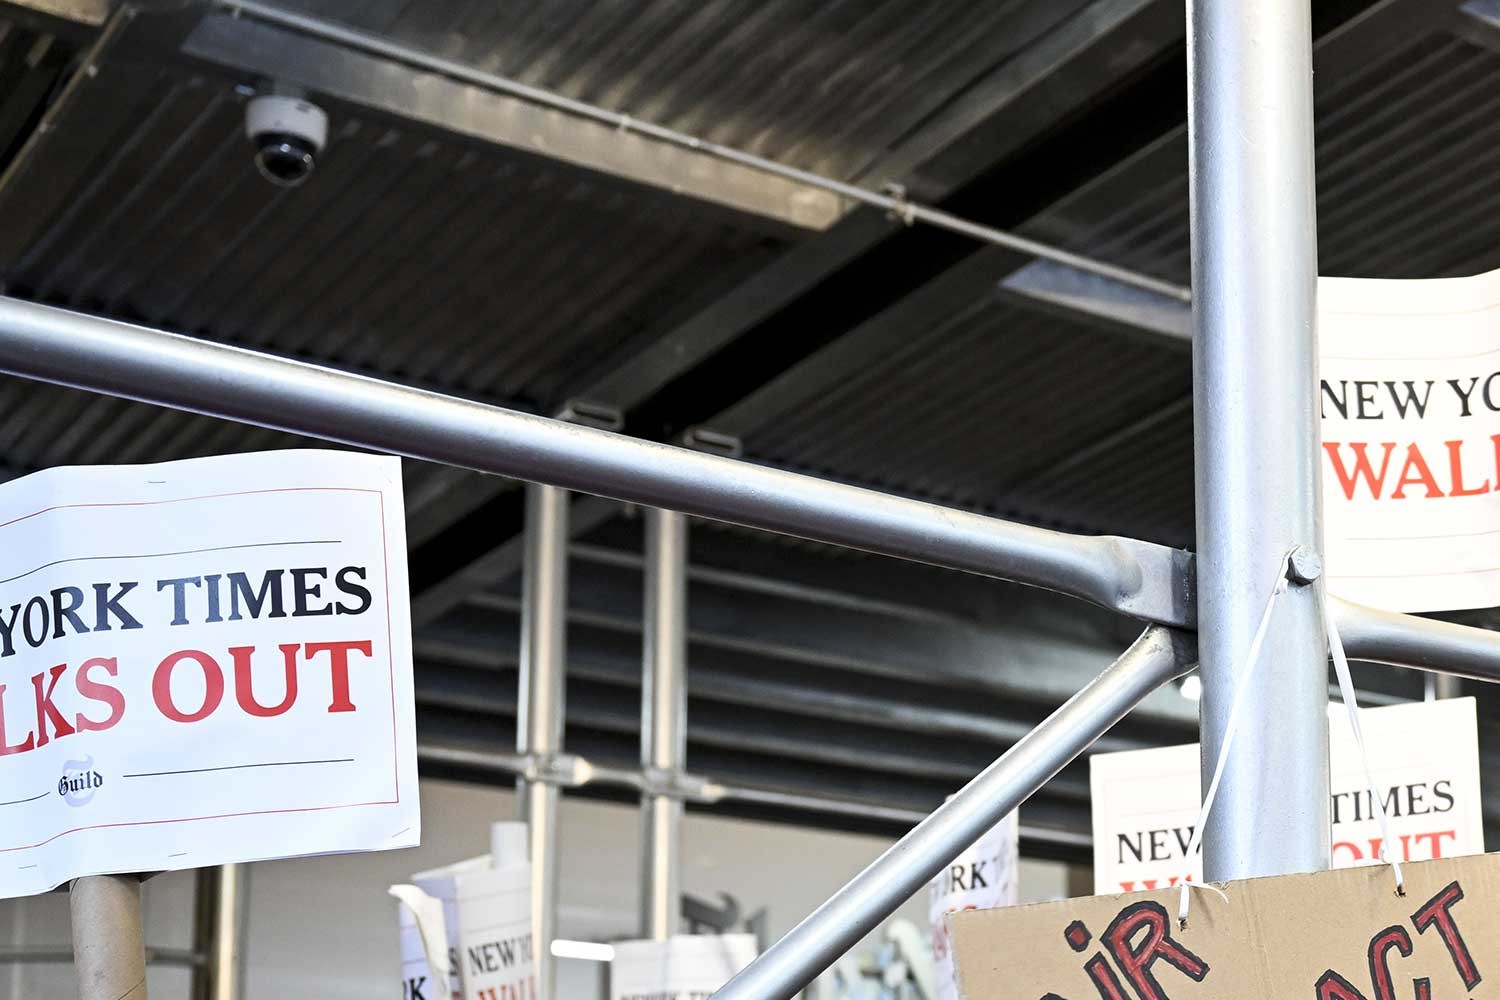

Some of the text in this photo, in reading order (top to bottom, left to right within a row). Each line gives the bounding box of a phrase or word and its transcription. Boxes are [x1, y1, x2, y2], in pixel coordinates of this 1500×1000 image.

[1320, 379, 1435, 421] NEW
[0, 566, 373, 658] YORK TIMES
[152, 640, 373, 724] OUT
[58, 771, 104, 797] Guild
[1332, 780, 1456, 825] TIMES
[468, 940, 515, 976] NEW
